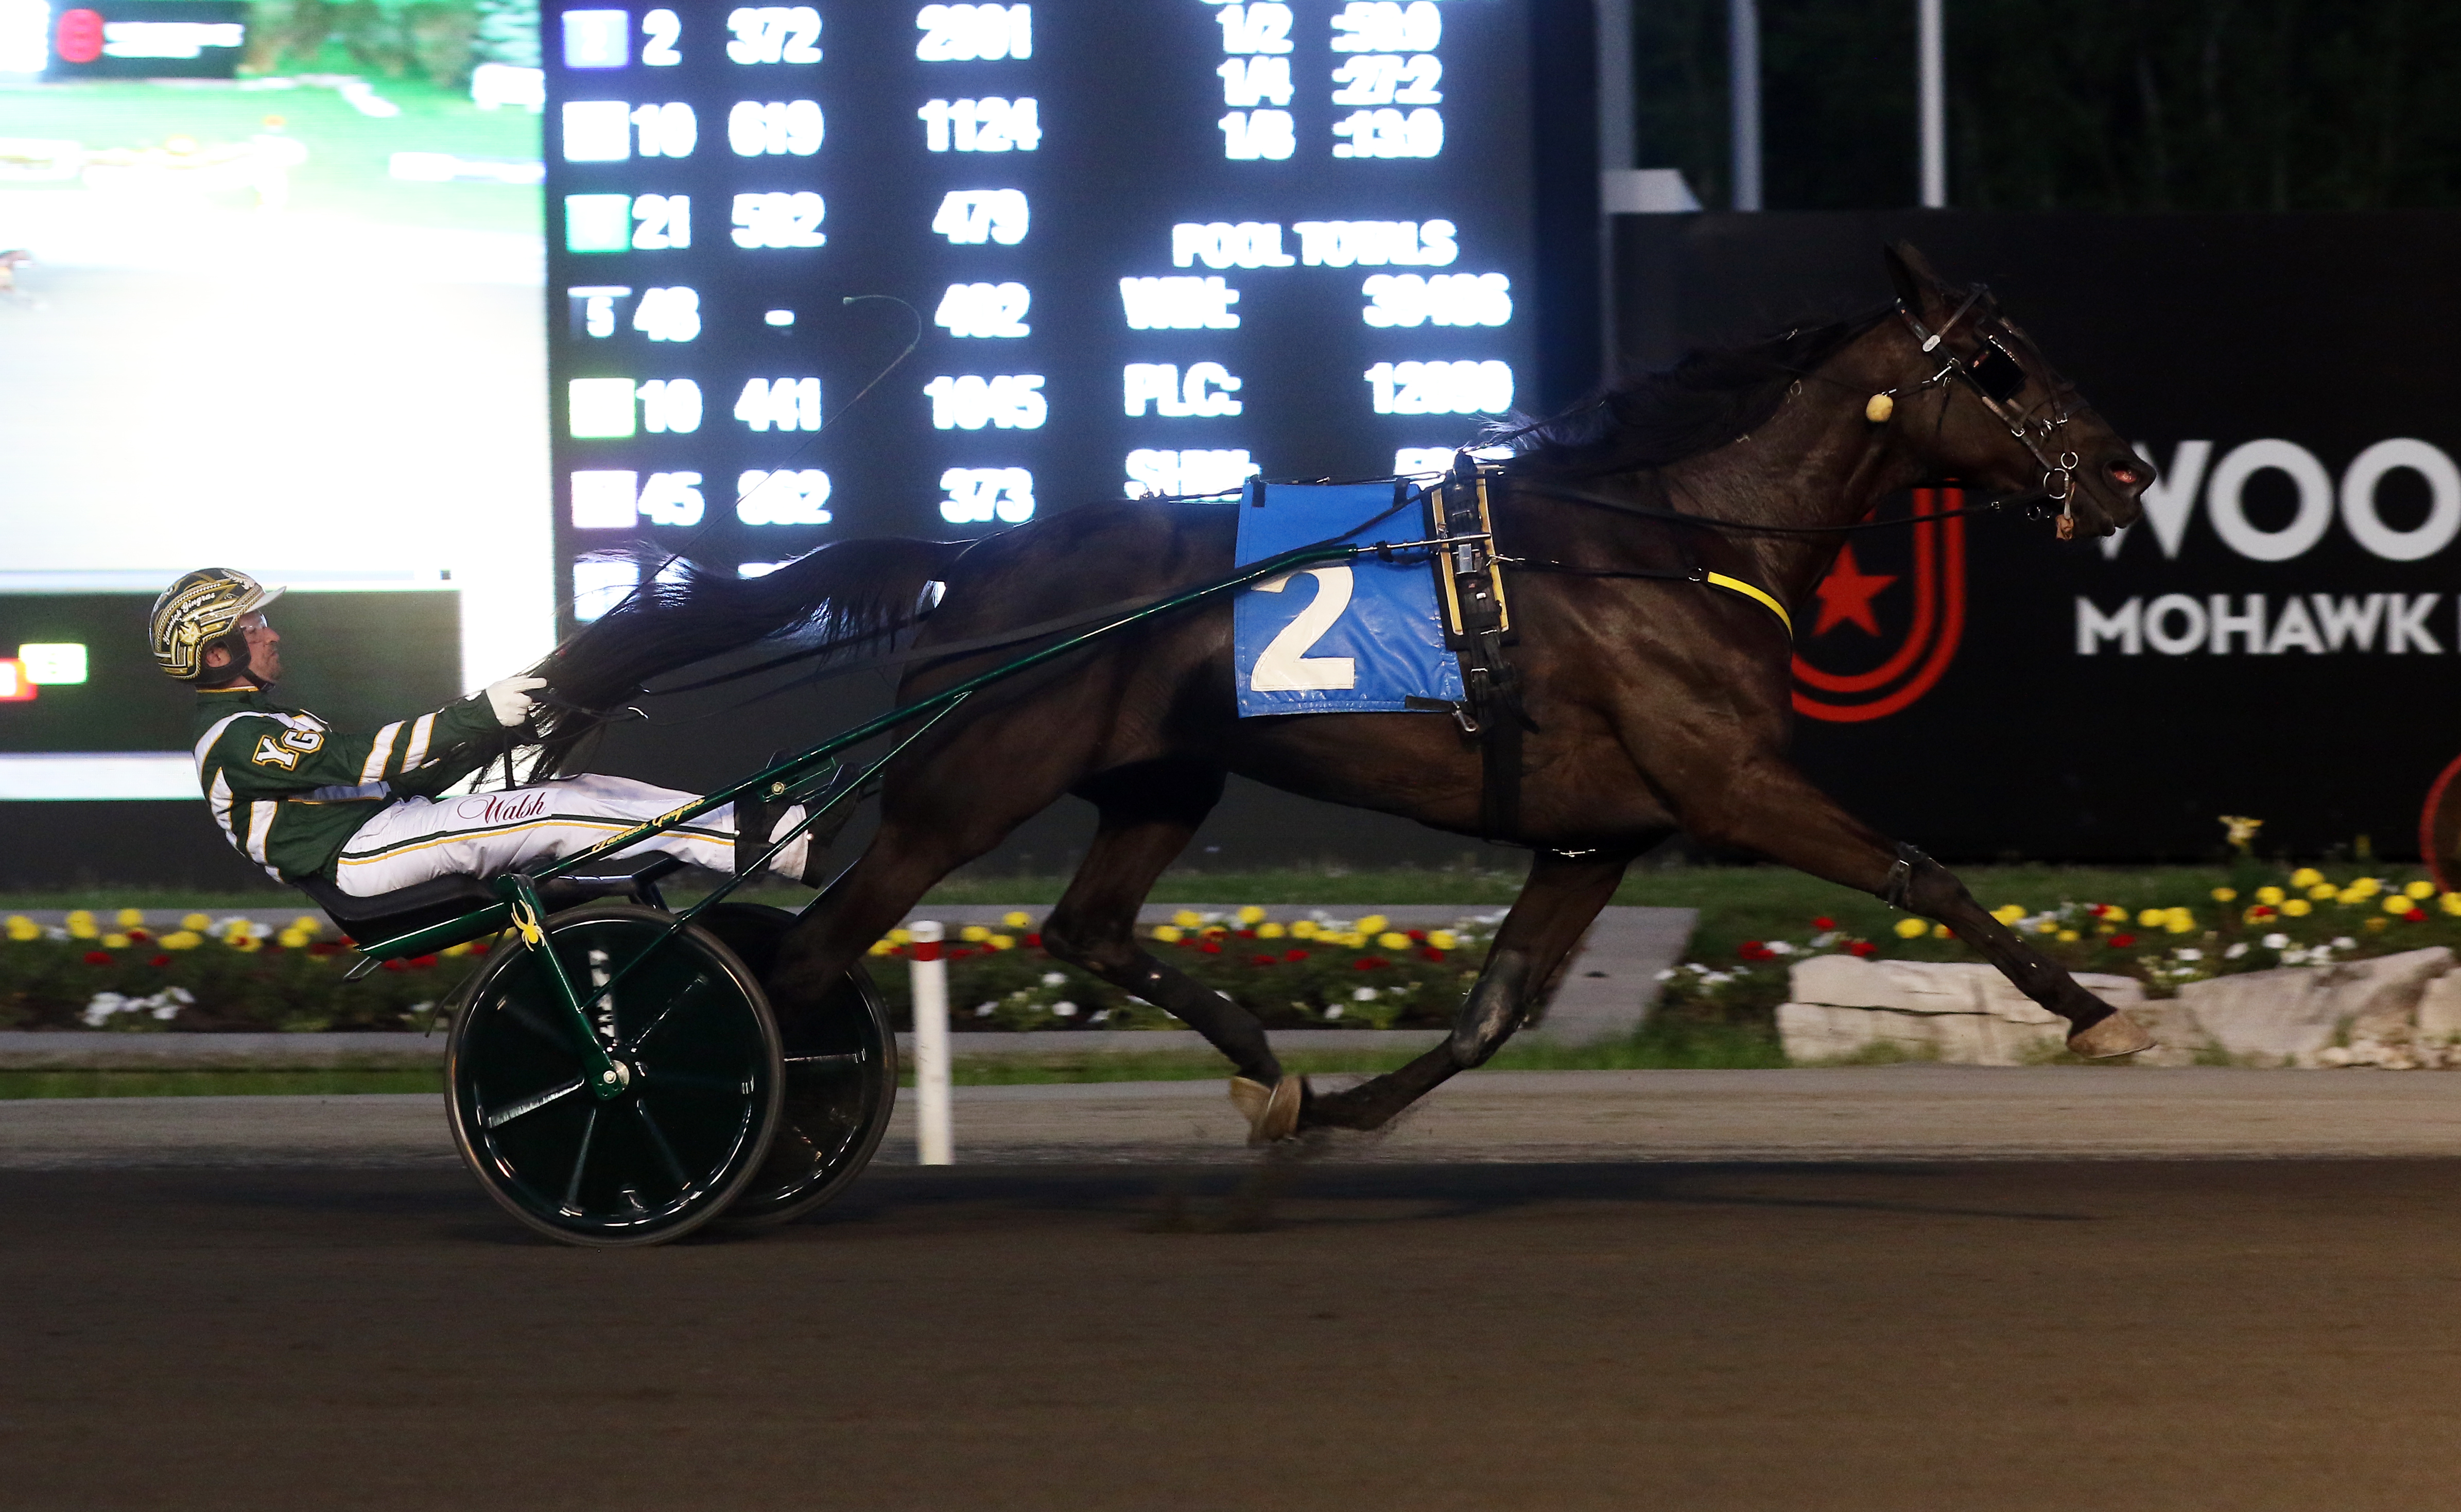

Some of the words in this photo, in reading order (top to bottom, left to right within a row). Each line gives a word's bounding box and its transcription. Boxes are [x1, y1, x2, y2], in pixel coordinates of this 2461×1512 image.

[642, 9, 681, 66] 2
[726, 6, 822, 64] 372
[1215, 2, 1294, 54] 1/2
[1217, 55, 1295, 106] 1/4
[631, 102, 698, 157] 10
[727, 99, 824, 156] 619
[917, 97, 1043, 152] 1124
[632, 194, 691, 249] 21
[932, 188, 1029, 245] 479
[1172, 221, 1295, 269] POOL
[1292, 219, 1458, 267] TOTALS
[635, 378, 702, 433] 10
[733, 377, 822, 431] 441
[1123, 362, 1242, 416] PLC:
[638, 472, 704, 525] 45
[940, 467, 1034, 523] 373
[181, 592, 216, 613] Gingras
[1251, 559, 1355, 691] 2
[2074, 592, 2443, 656] MOHAWK
[252, 729, 325, 771] YG
[457, 790, 547, 824] Walsh
